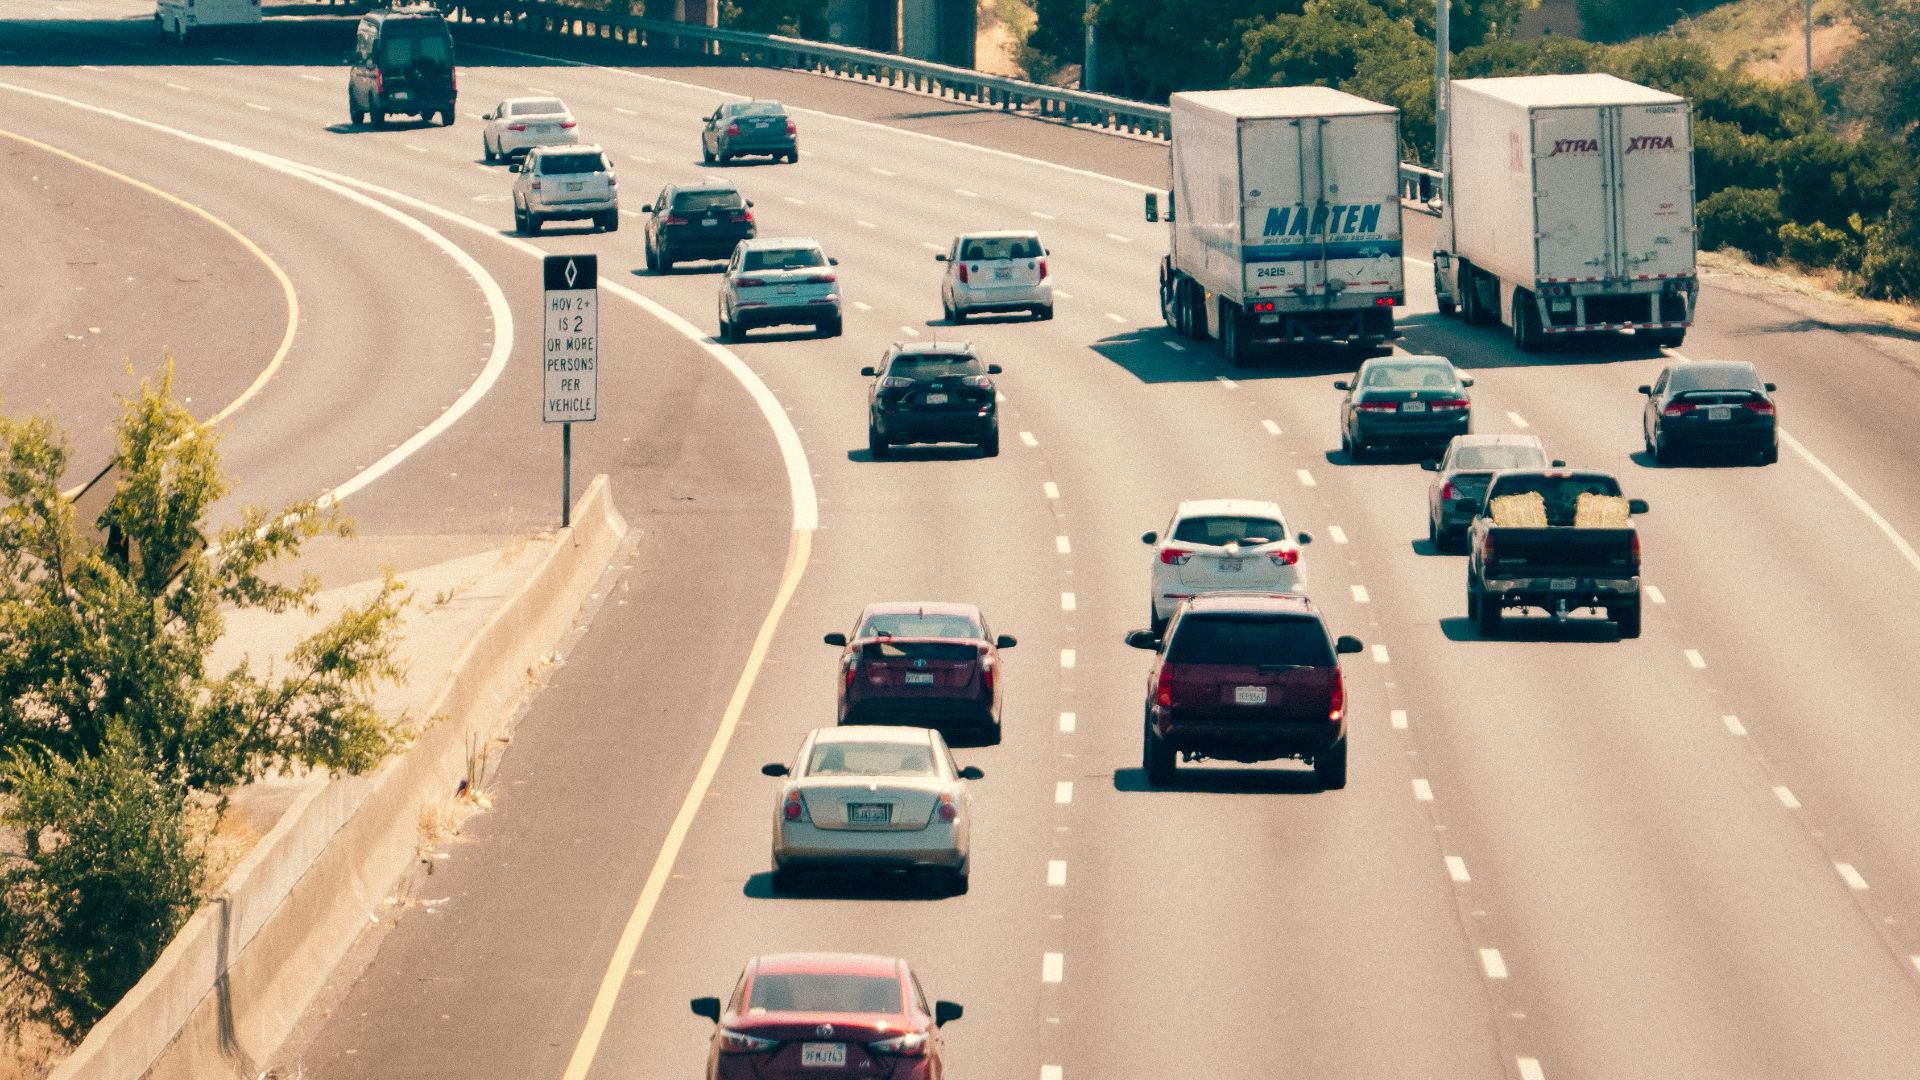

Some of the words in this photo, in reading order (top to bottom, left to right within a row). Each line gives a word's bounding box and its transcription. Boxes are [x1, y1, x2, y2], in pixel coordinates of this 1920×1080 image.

[1550, 138, 1599, 157] XTRA
[1625, 135, 1675, 154] XTRA
[1263, 204, 1382, 235] MARTEN
[552, 298, 571, 310] HOV
[576, 297, 591, 310] 2+
[559, 318, 569, 330] IS
[574, 315, 583, 332] 2
[547, 338, 561, 351] OR
[566, 337, 594, 350] MORE
[547, 358, 594, 371] PERSONS
[561, 379, 580, 391] PER
[549, 398, 592, 411] VEHICLE
